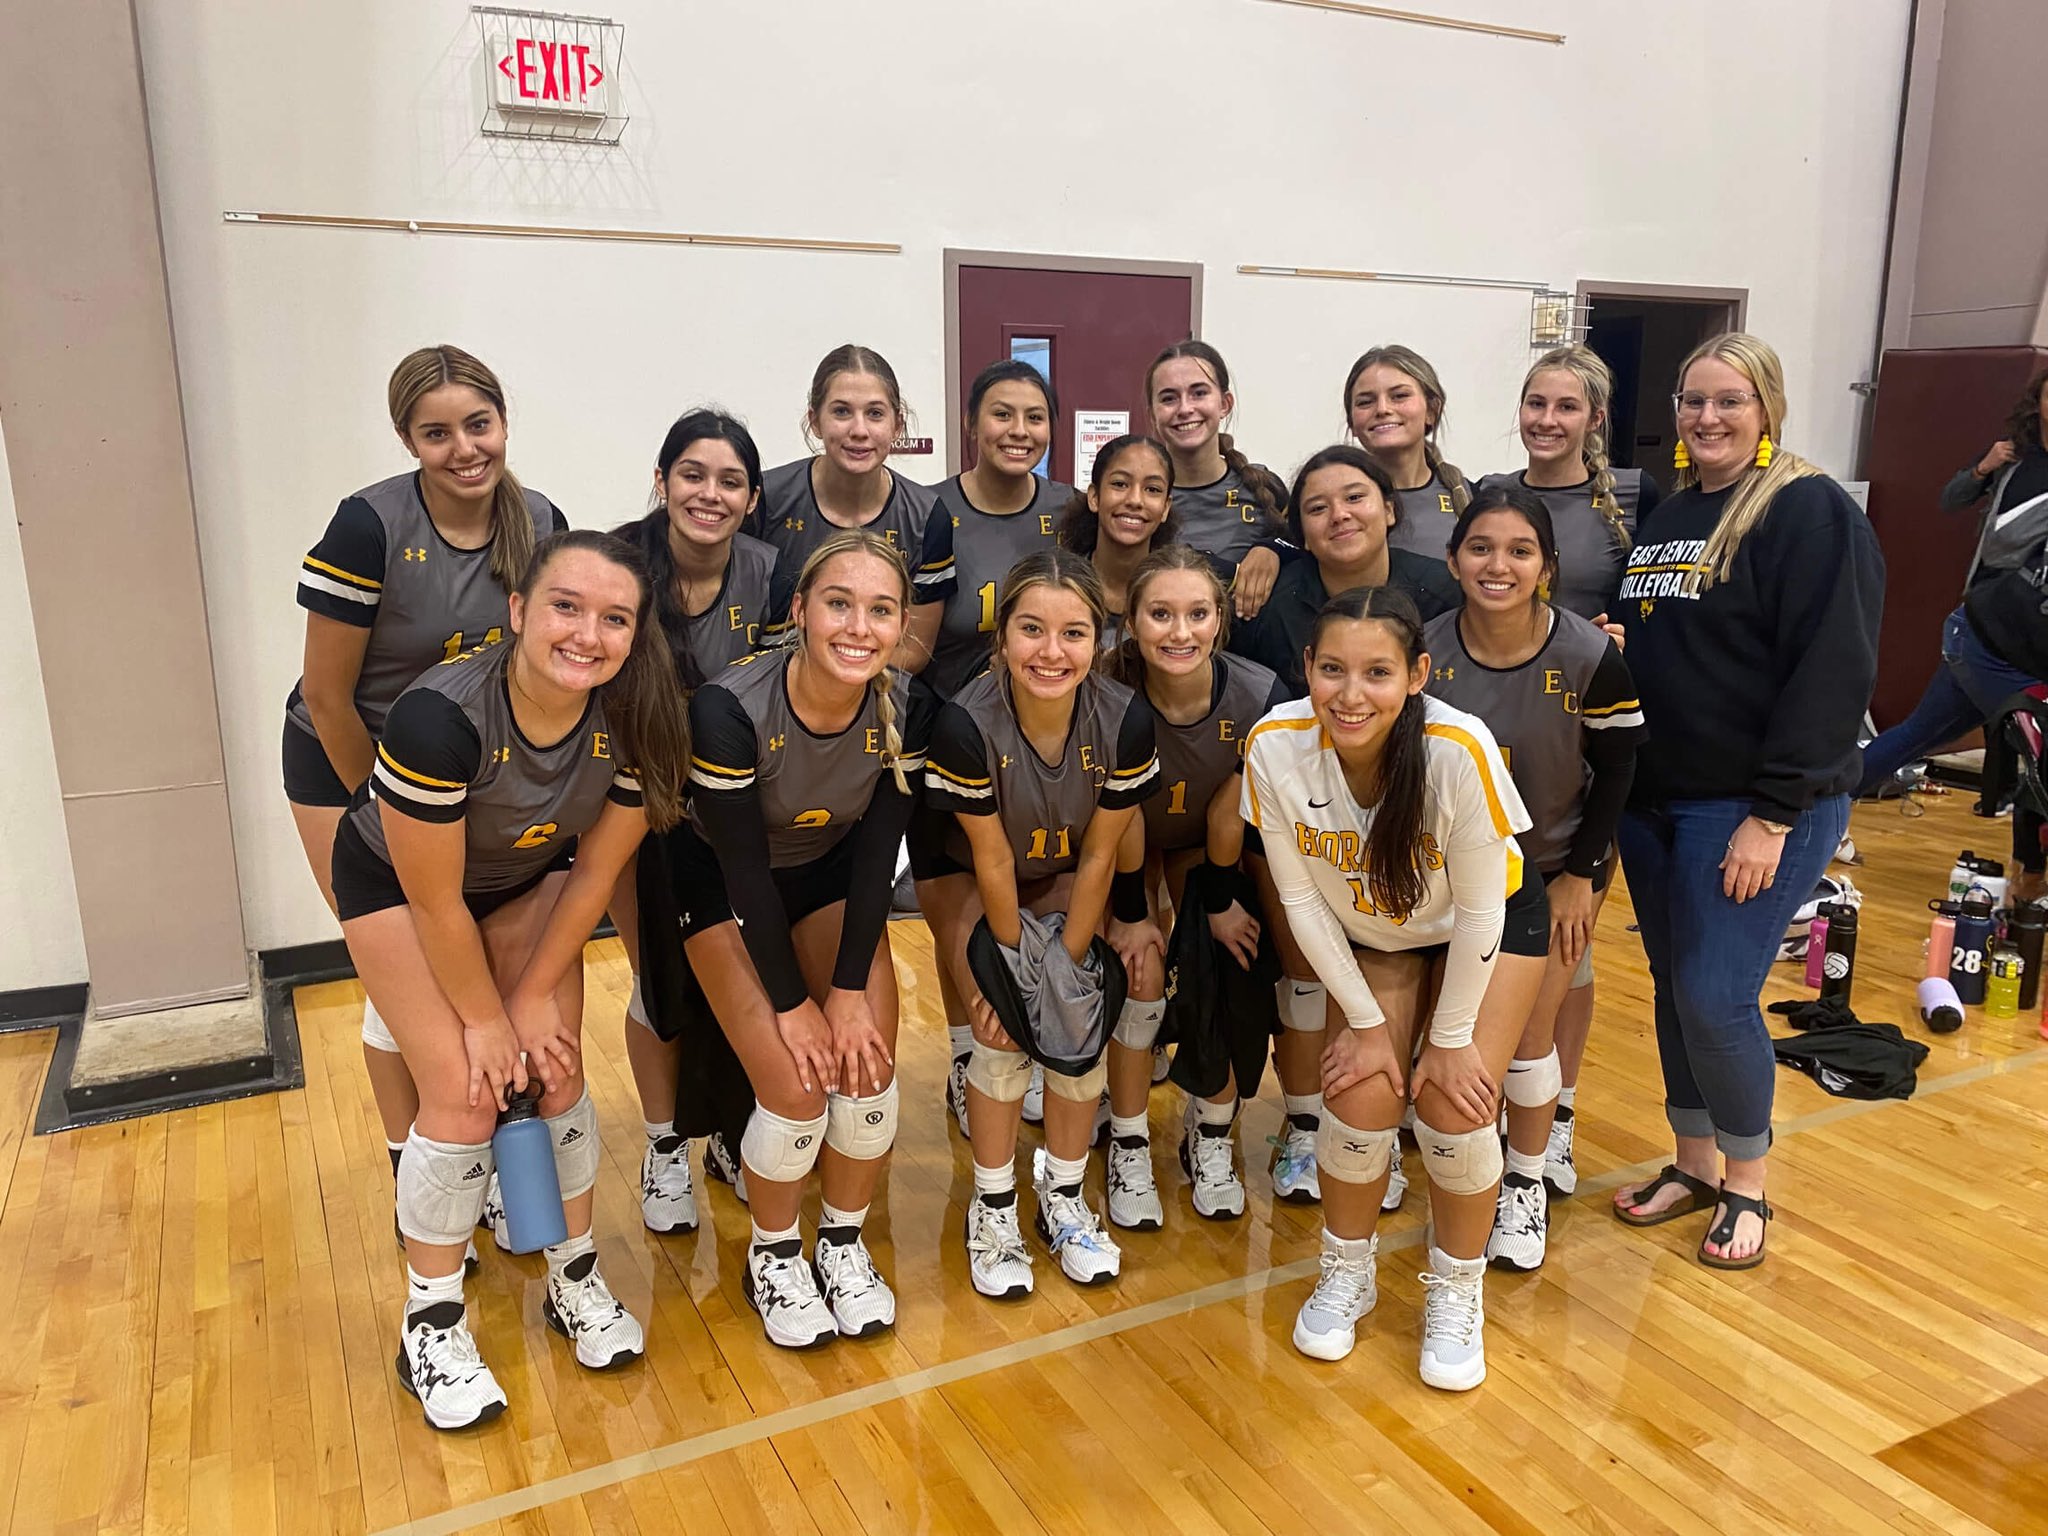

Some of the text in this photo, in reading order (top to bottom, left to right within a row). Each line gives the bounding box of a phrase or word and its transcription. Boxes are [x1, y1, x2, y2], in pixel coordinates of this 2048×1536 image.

[516, 38, 590, 103] EXIT
[1627, 540, 1718, 567] EAST CENTR
[1167, 780, 1187, 815] 1
[1026, 825, 1072, 859] 11
[1294, 821, 1445, 872] HORS
[1951, 945, 1983, 974] 28
